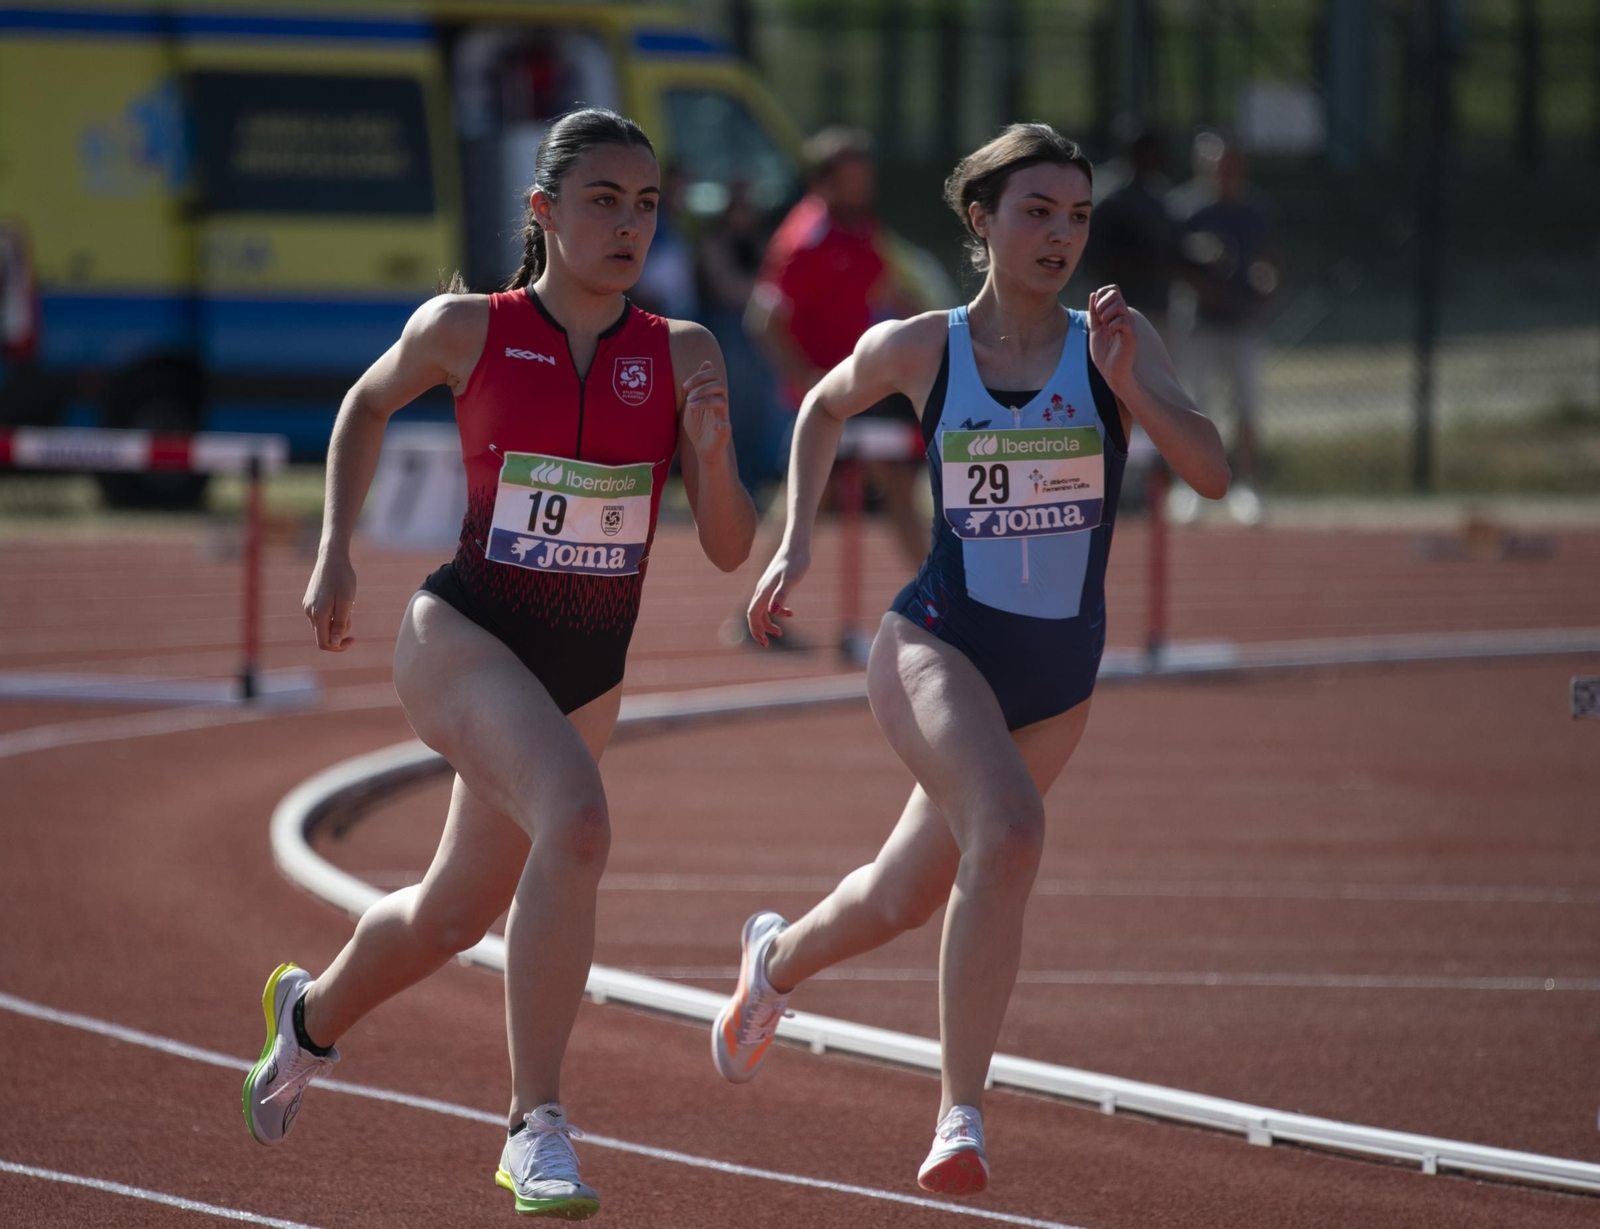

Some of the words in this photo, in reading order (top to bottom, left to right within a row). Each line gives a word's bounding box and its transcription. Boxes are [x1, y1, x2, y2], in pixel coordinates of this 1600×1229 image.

[1002, 436, 1080, 454] Iberdrola
[565, 470, 636, 492] Iberdrola
[967, 463, 1010, 505] 29
[527, 490, 568, 536] 19
